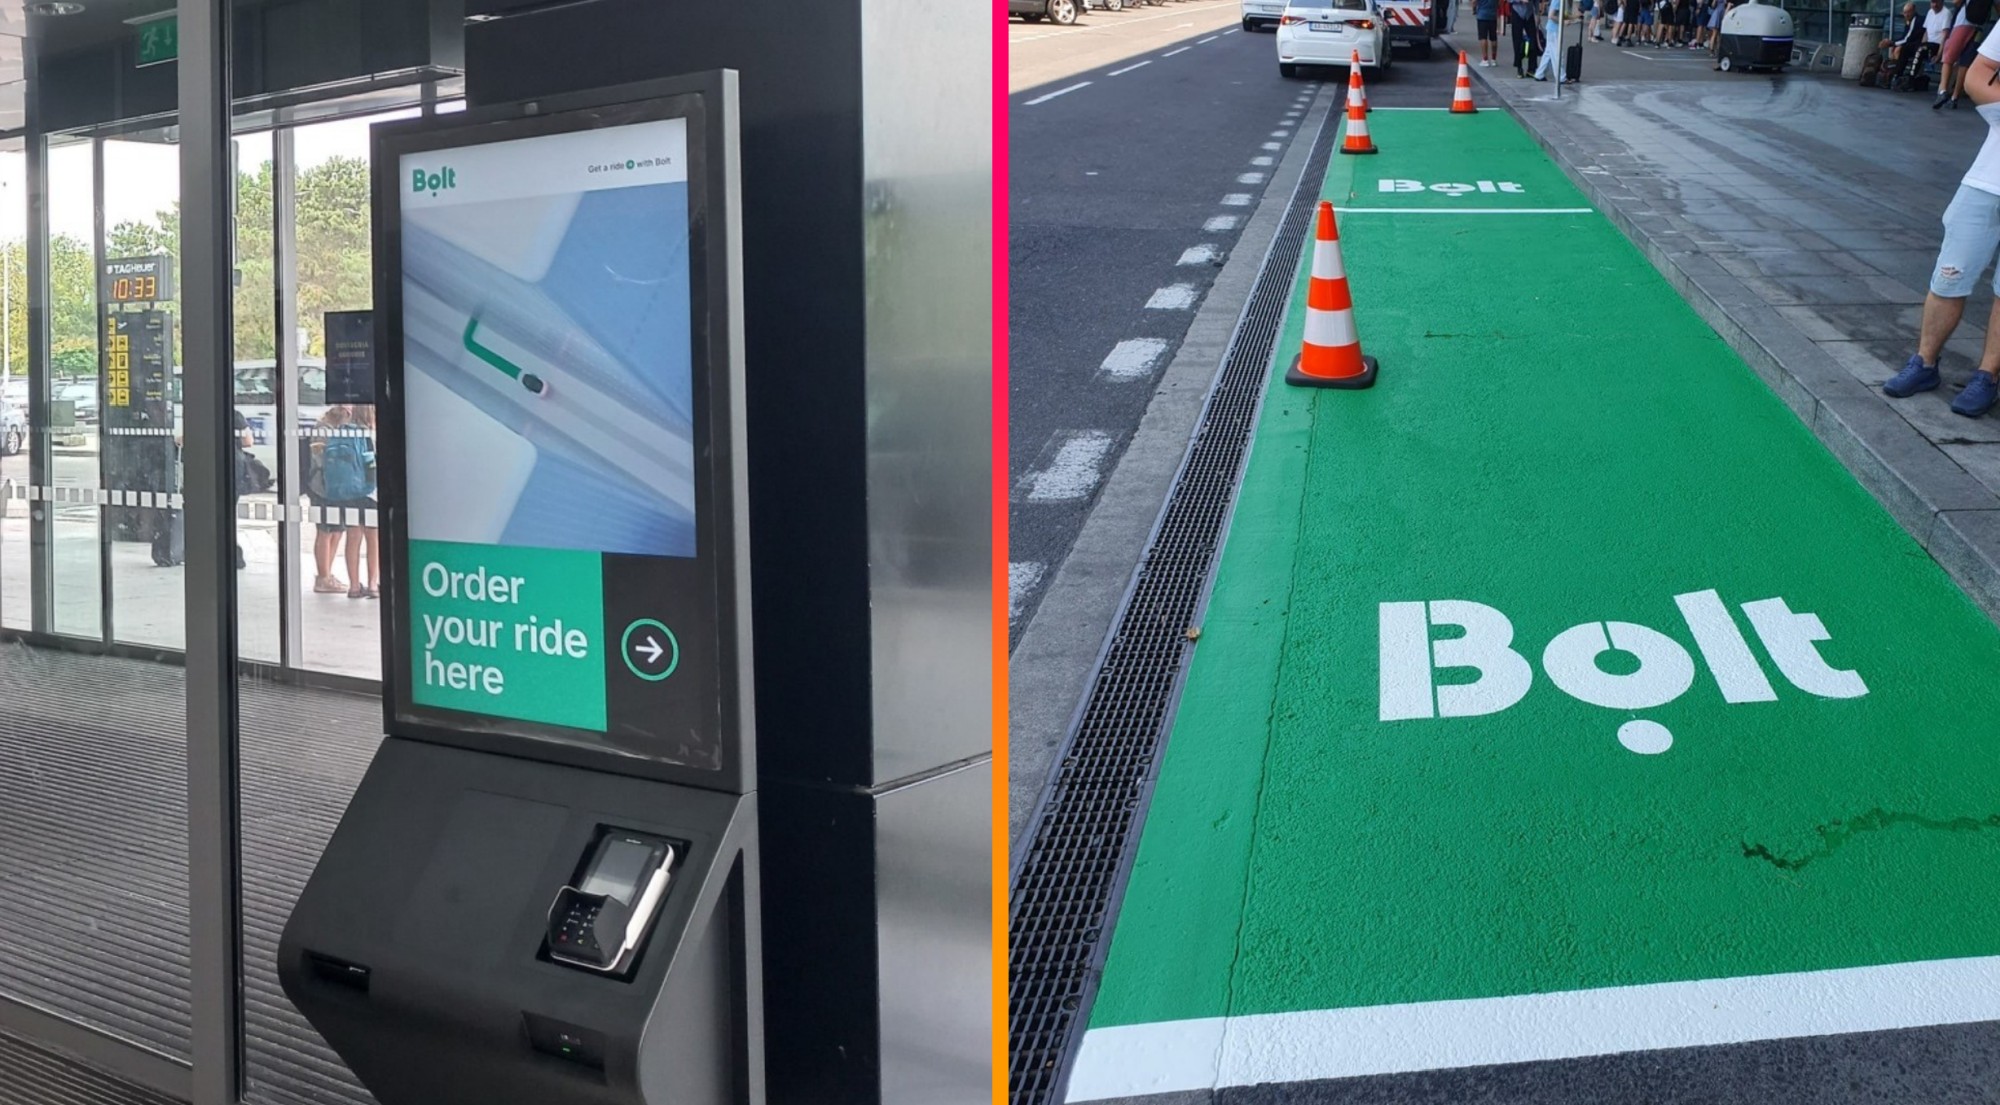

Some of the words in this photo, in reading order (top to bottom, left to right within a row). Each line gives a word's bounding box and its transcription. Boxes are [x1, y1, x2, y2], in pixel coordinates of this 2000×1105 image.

[412, 166, 456, 197] Bolt
[587, 164, 602, 173] Get
[602, 164, 609, 172] a
[609, 162, 625, 171] ride
[636, 159, 654, 168] with
[655, 157, 671, 166] Bolt
[1378, 179, 1526, 197] Bolt
[113, 277, 155, 299] 10:33
[422, 561, 525, 604] Order
[423, 613, 503, 649] your
[514, 615, 588, 658] ride
[425, 650, 504, 694] here
[1379, 588, 1870, 755] Bolt
